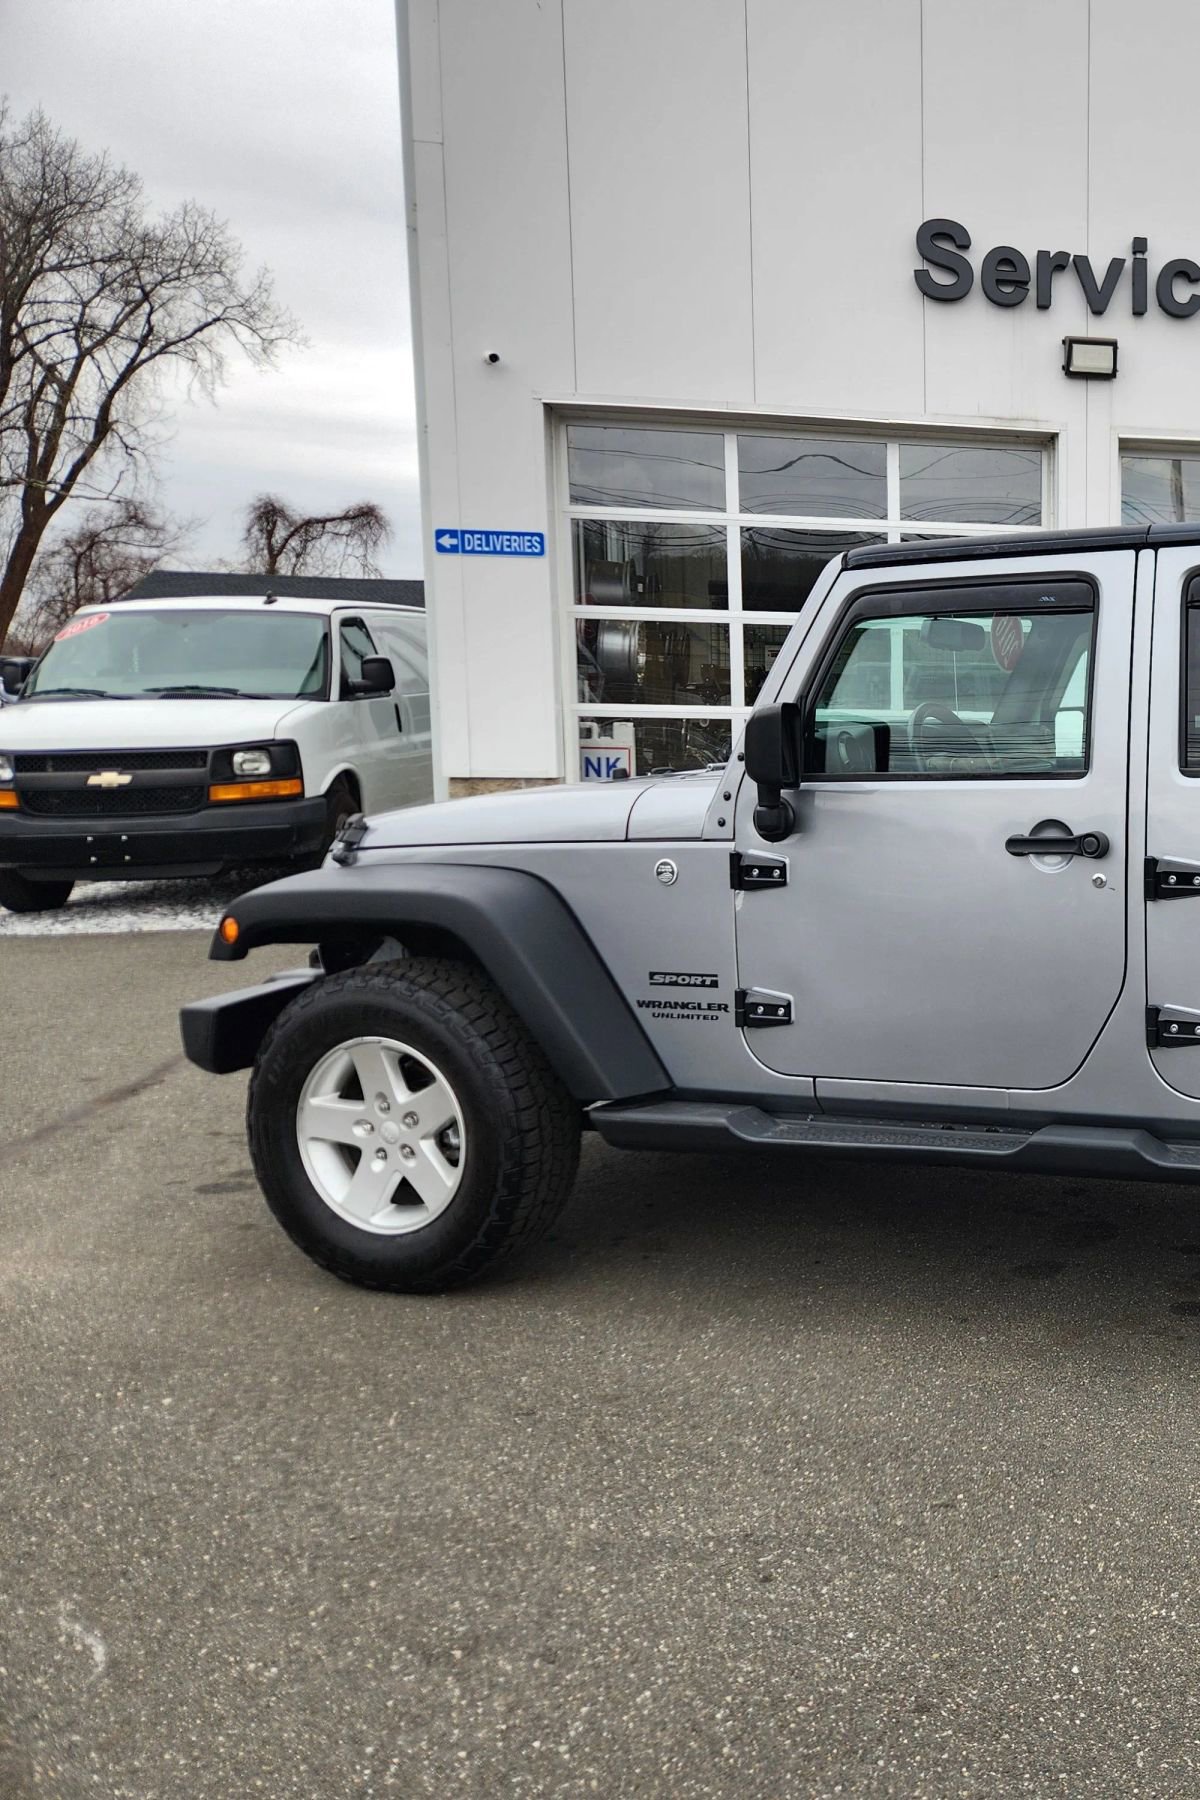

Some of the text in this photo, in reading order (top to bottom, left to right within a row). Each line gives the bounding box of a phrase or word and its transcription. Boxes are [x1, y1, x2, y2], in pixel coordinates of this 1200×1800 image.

[464, 533, 541, 553] DELIVERIES
[650, 974, 719, 985] SPORT
[636, 999, 730, 1013] WRANGLER
[652, 1011, 719, 1021] UNLIMITED
